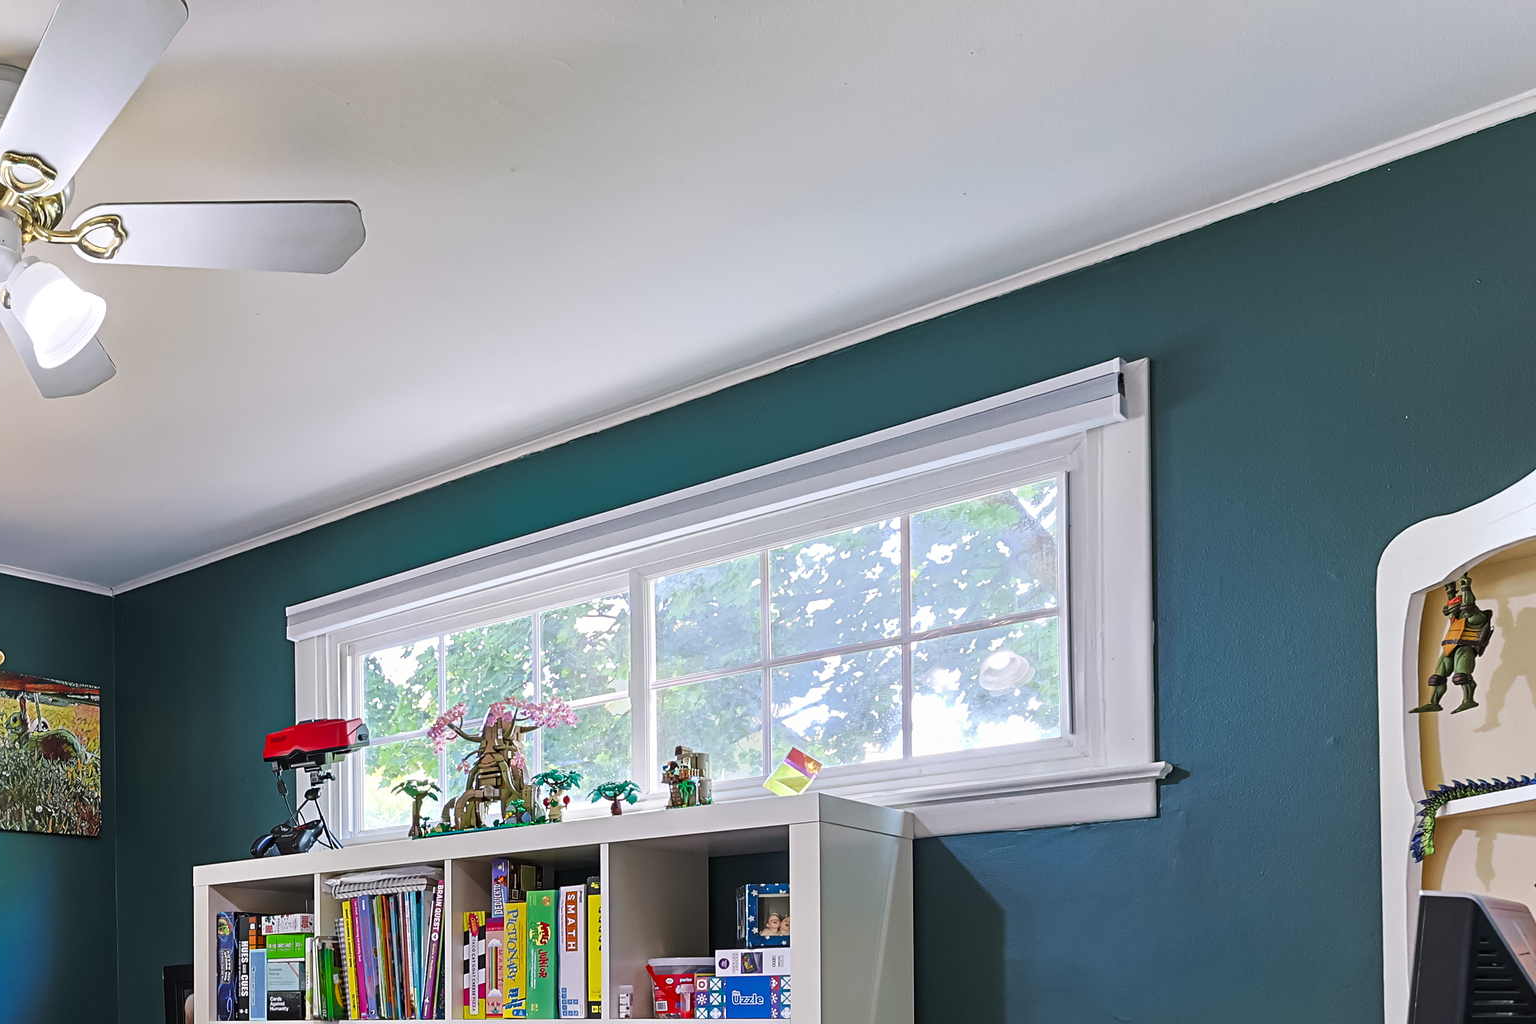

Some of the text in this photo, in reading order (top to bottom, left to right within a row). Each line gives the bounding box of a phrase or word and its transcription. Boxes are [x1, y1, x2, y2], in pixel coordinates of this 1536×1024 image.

[432, 884, 444, 931] BRAIN QUEST
[567, 893, 576, 949] SMATH
[241, 940, 249, 963] HUES
[506, 908, 519, 982] PICTIONARY
[241, 974, 249, 997] CUES
[732, 993, 764, 1005] Uzzle
